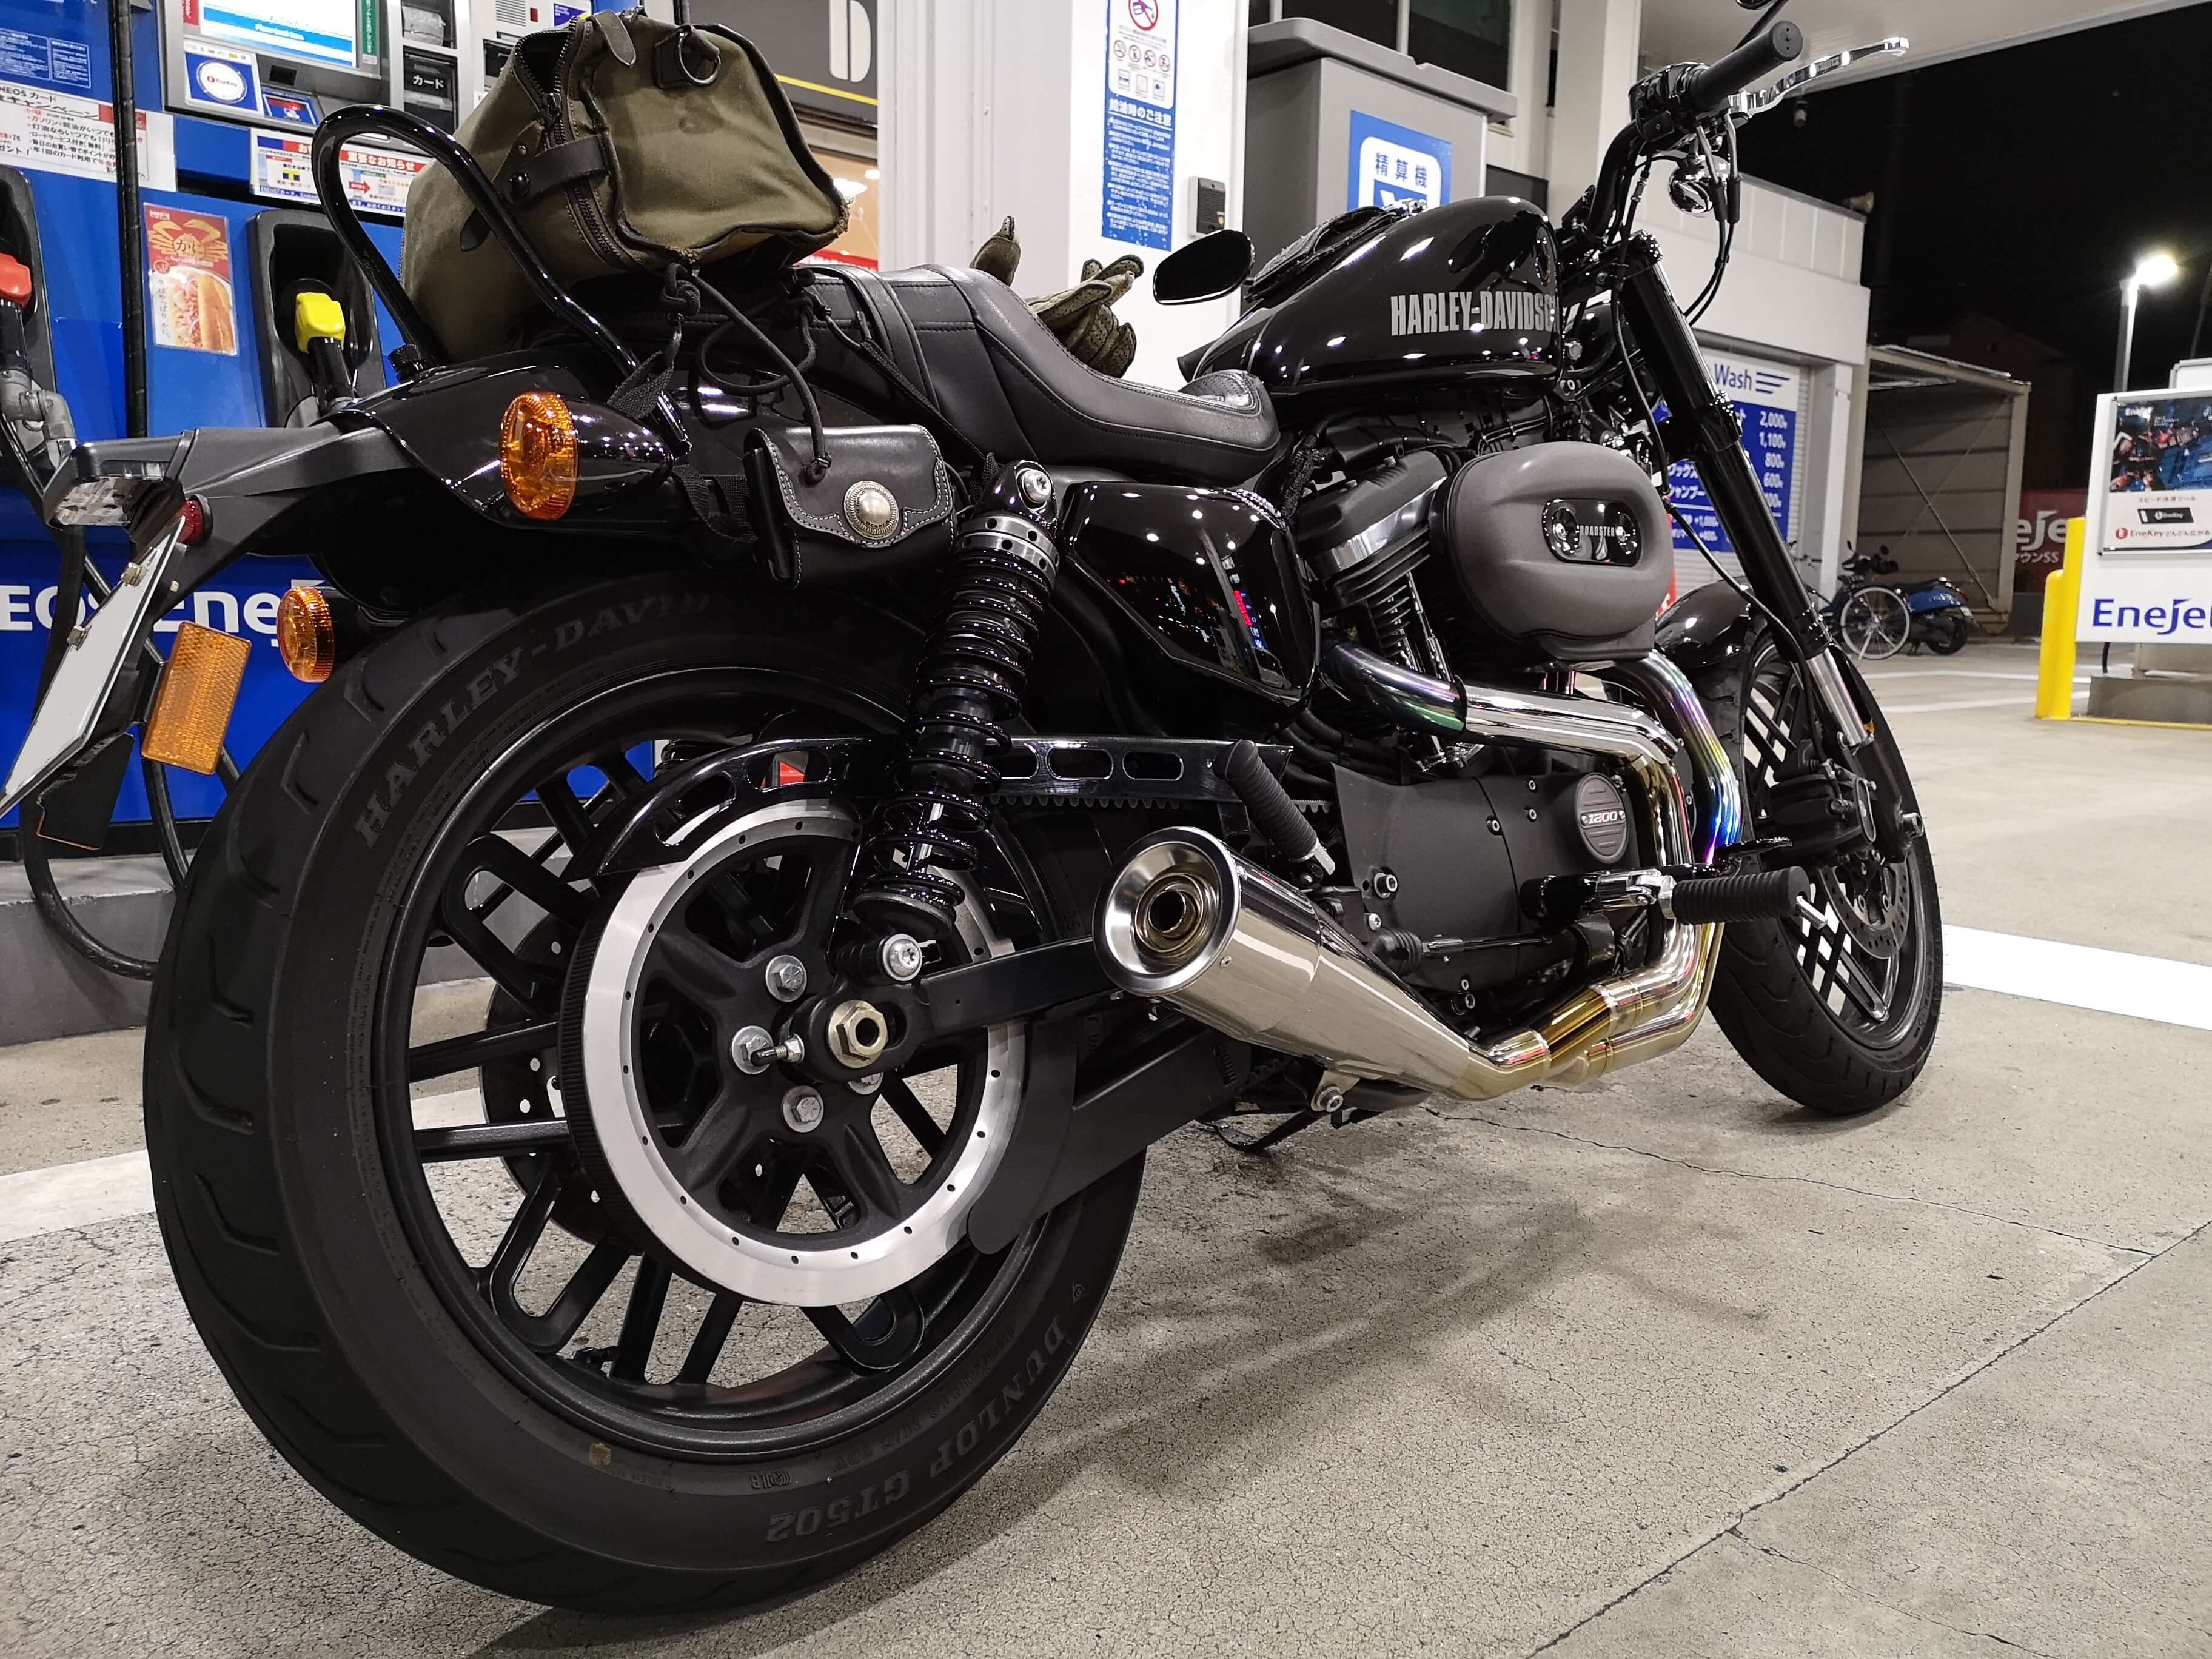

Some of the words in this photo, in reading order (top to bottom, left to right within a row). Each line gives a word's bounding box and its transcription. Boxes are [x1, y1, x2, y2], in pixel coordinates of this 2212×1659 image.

[412, 74, 444, 89] カード
[30, 90, 56, 102] カード
[348, 151, 417, 171] 重要なお知らせ
[1375, 152, 1427, 188] 精算機
[1714, 363, 1752, 391] Wash
[1580, 525, 1615, 537] ROADSTER
[2016, 551, 2059, 563] ウンSS
[1587, 810, 1618, 825] 1200
[928, 1315, 1065, 1480] DUNLOP
[765, 1469, 910, 1543] GT502
